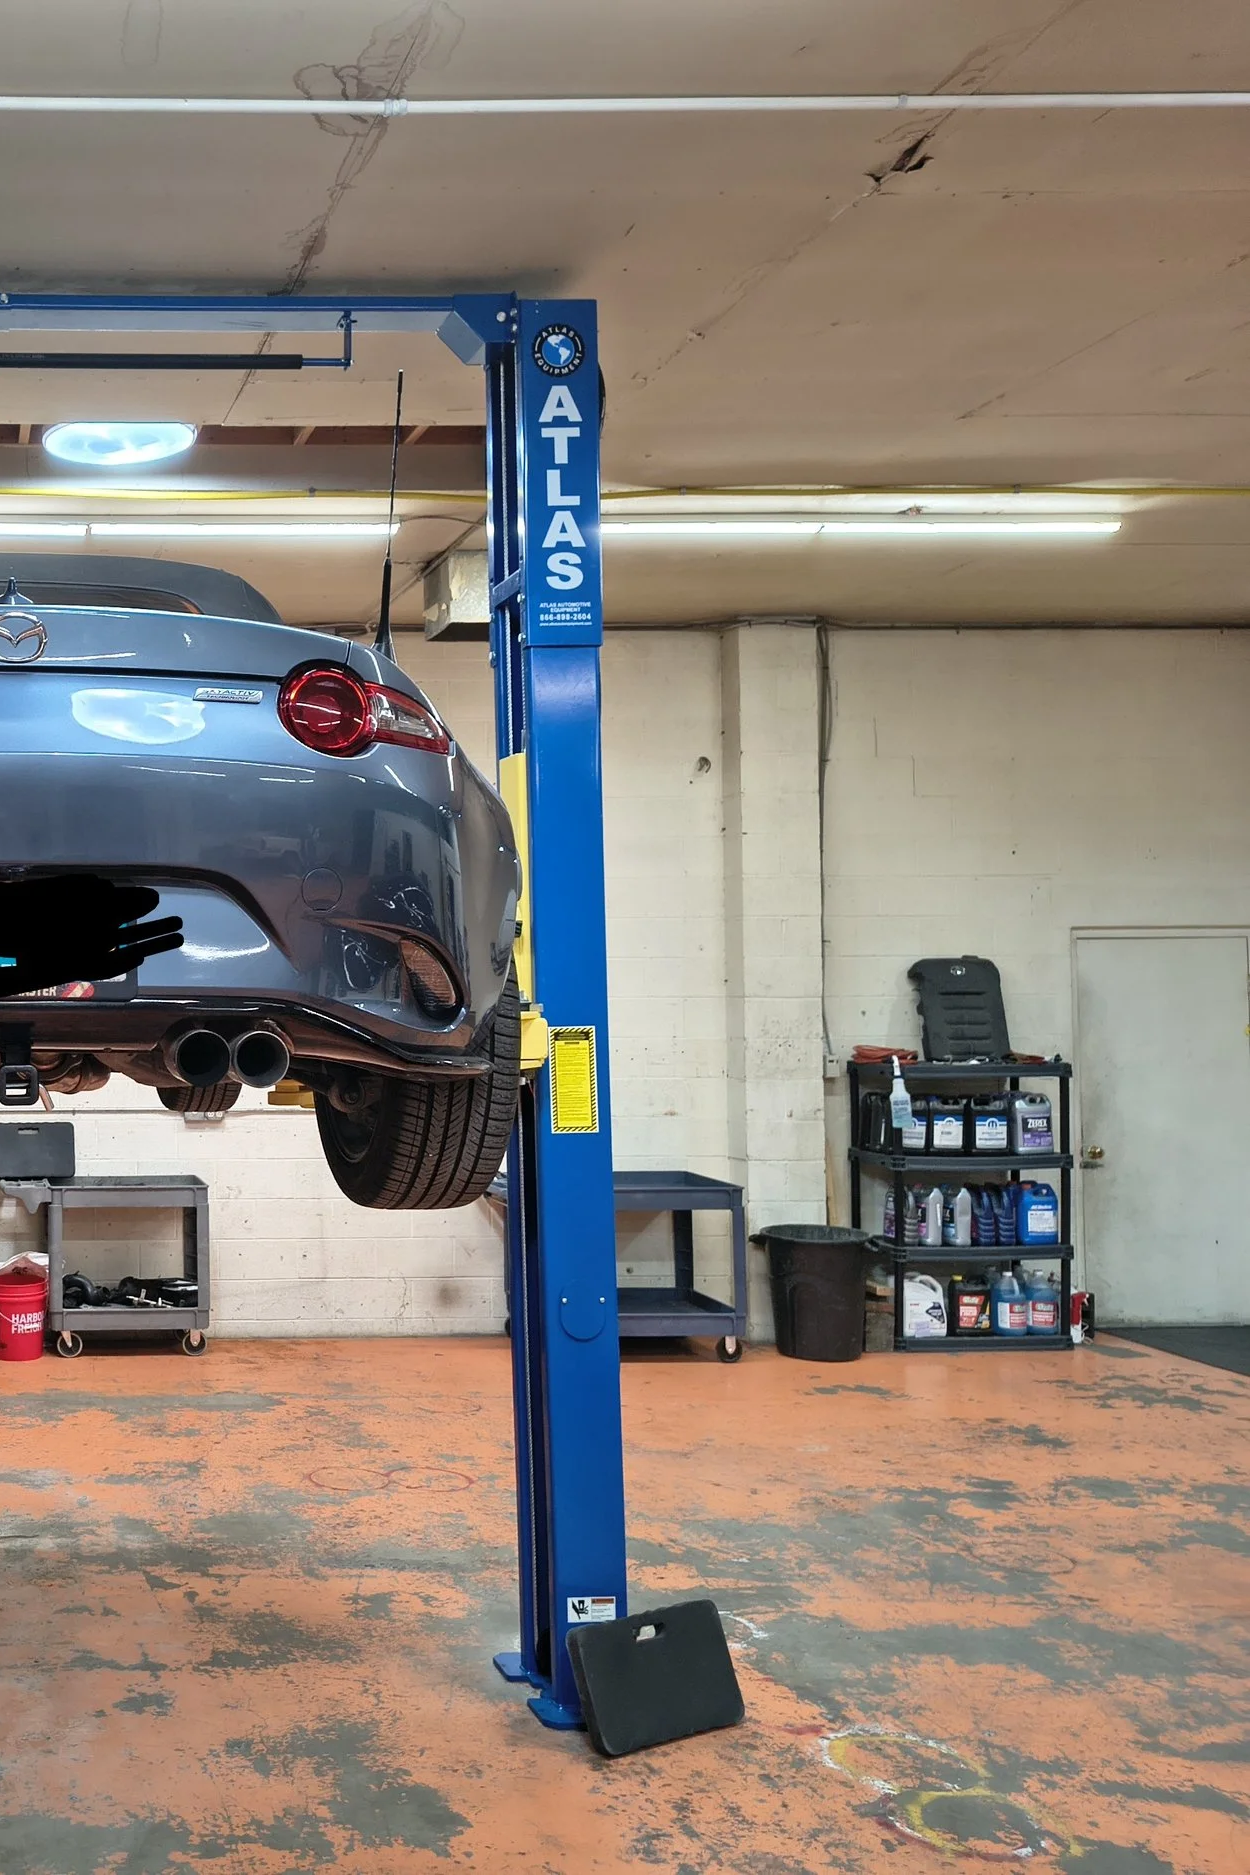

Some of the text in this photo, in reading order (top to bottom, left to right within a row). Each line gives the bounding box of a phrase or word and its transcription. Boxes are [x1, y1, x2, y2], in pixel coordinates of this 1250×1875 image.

[542, 326, 575, 338] ATLAS
[535, 352, 582, 375] EQUIPMENT
[538, 385, 586, 590] ATLAS
